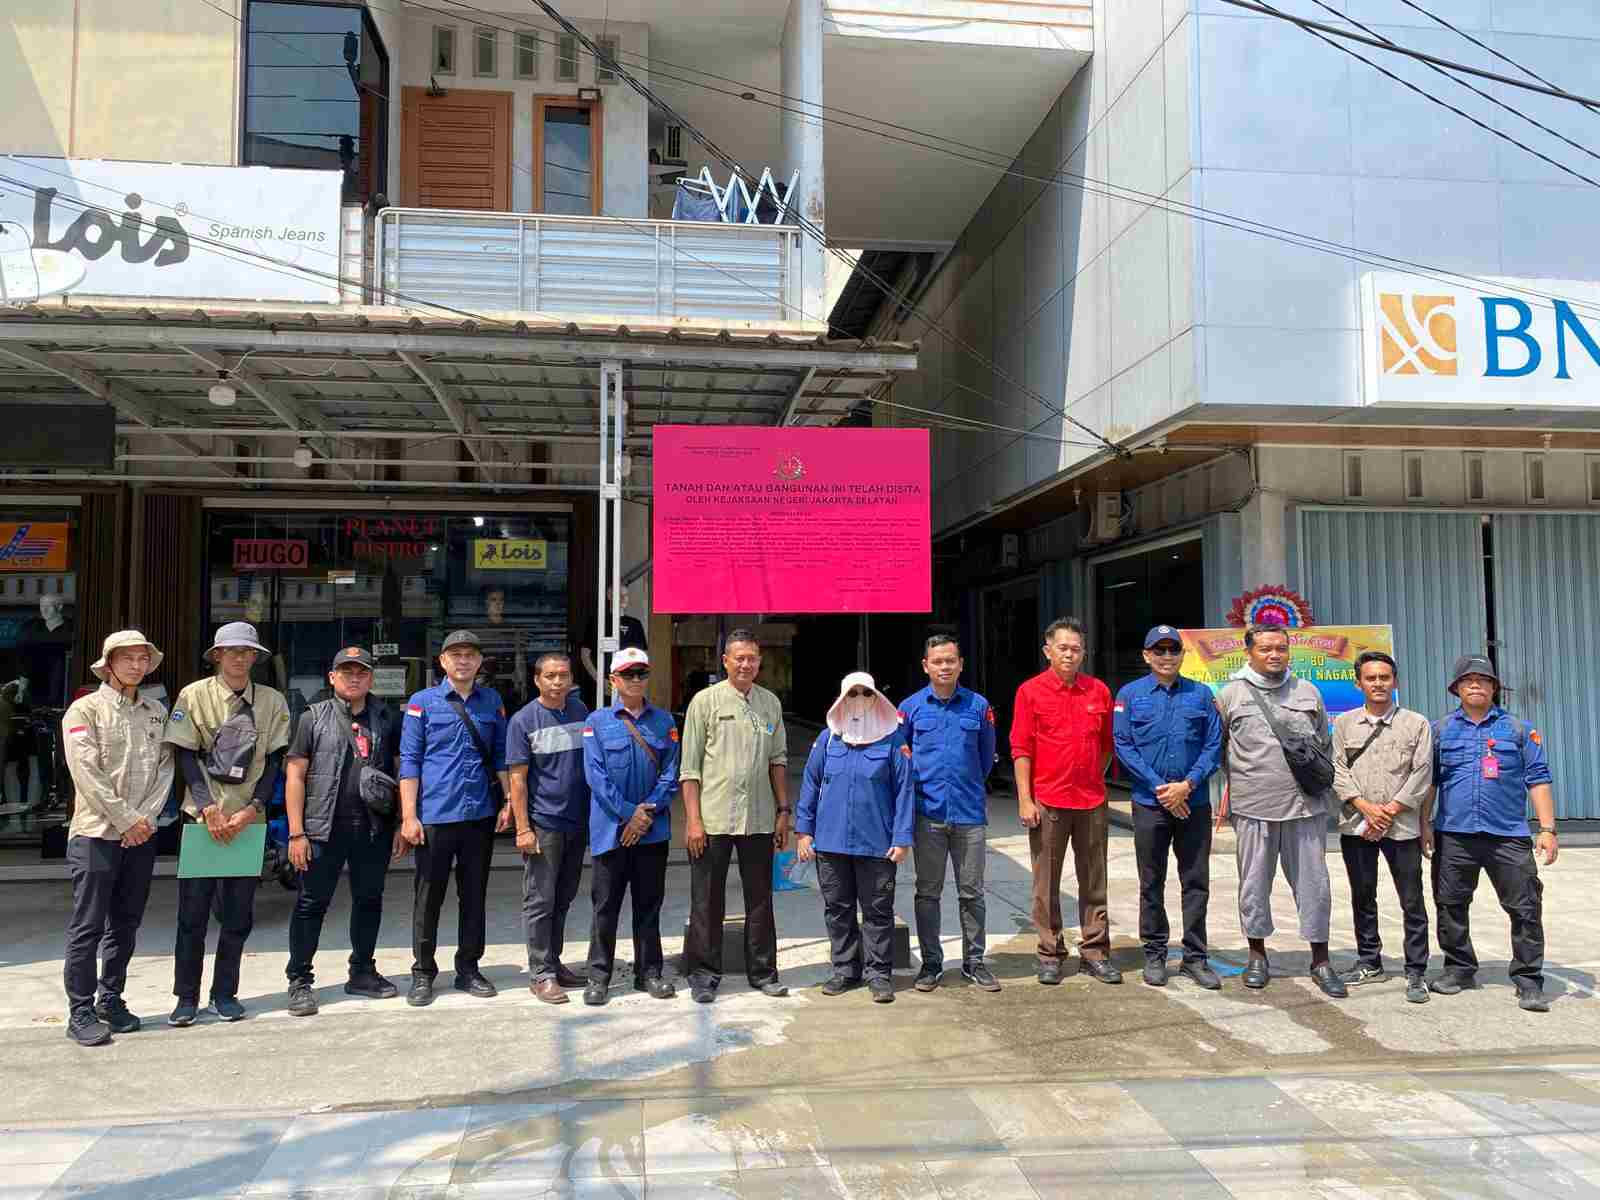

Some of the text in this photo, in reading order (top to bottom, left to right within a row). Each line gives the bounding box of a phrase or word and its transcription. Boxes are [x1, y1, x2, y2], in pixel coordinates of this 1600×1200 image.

[33, 187, 190, 267] Lois
[208, 223, 326, 242] Spanish Jeans
[664, 483, 703, 493] TANAH
[766, 484, 828, 494] BANGUNAN
[832, 485, 845, 494] INI
[848, 485, 883, 494] TELAH
[886, 485, 921, 495] DISITA
[686, 495, 711, 504] OLEH
[714, 496, 770, 505] KEJAKSAAN
[810, 496, 853, 505] JAKARTA
[856, 496, 898, 505] SELATAN
[236, 544, 305, 565] HUGO
[501, 544, 541, 560] Lois
[1315, 669, 1355, 681] NAGAR
